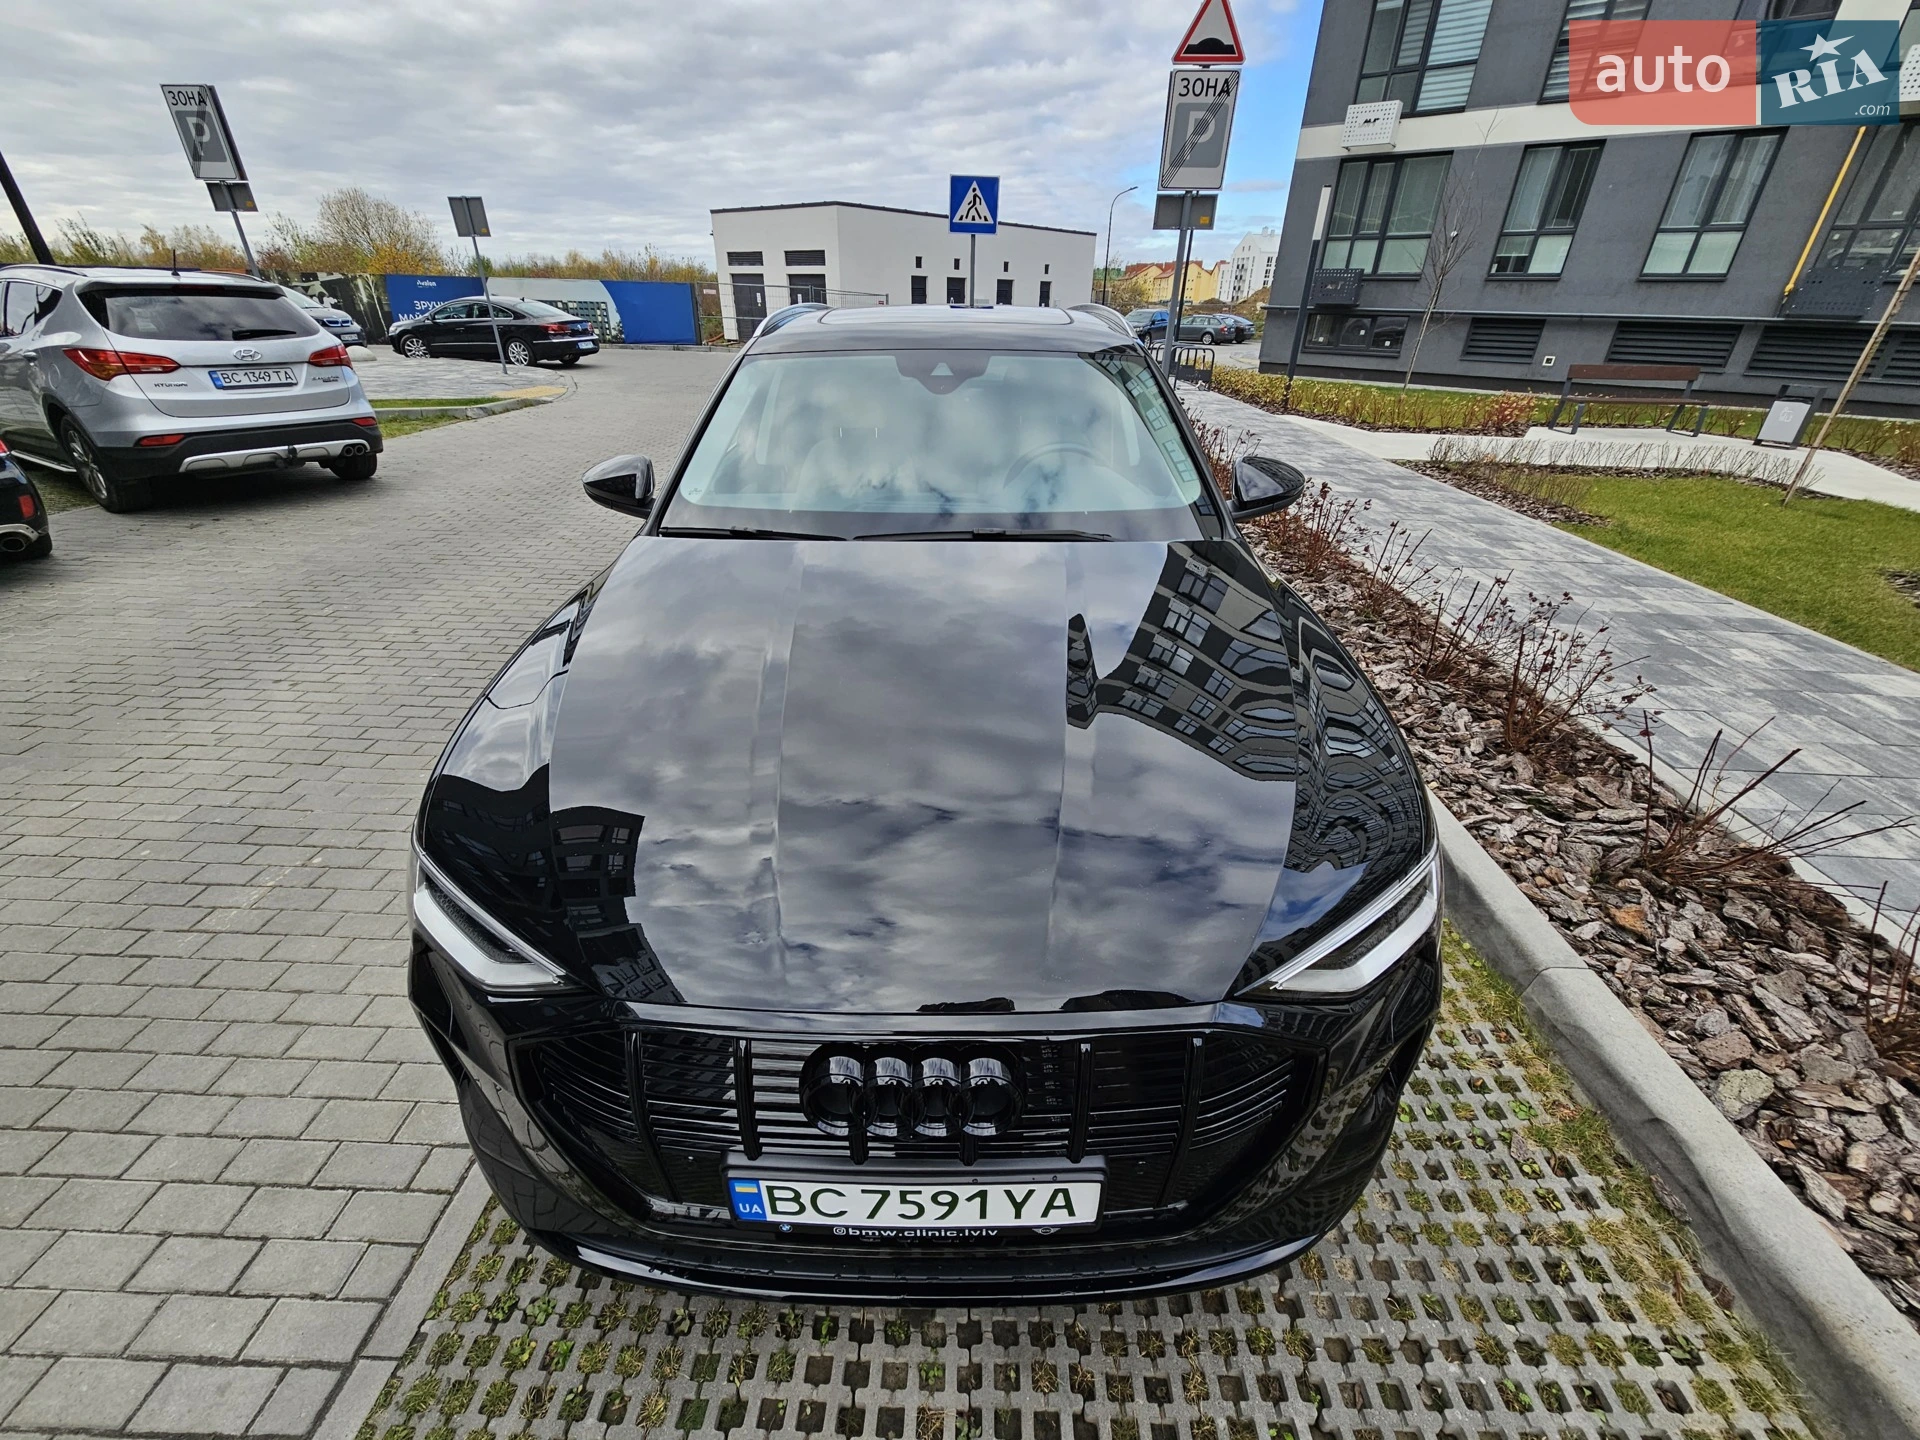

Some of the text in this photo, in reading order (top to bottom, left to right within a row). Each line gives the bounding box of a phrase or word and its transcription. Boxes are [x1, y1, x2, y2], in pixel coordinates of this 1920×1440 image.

[1178, 77, 1231, 98] ЗОНА
[167, 90, 208, 107] ЗОНА
[221, 374, 242, 385] BC
[244, 371, 271, 383] 1349
[272, 370, 294, 381] TA
[739, 1203, 763, 1214] UA
[765, 1185, 1077, 1221] BC 7591 YA
